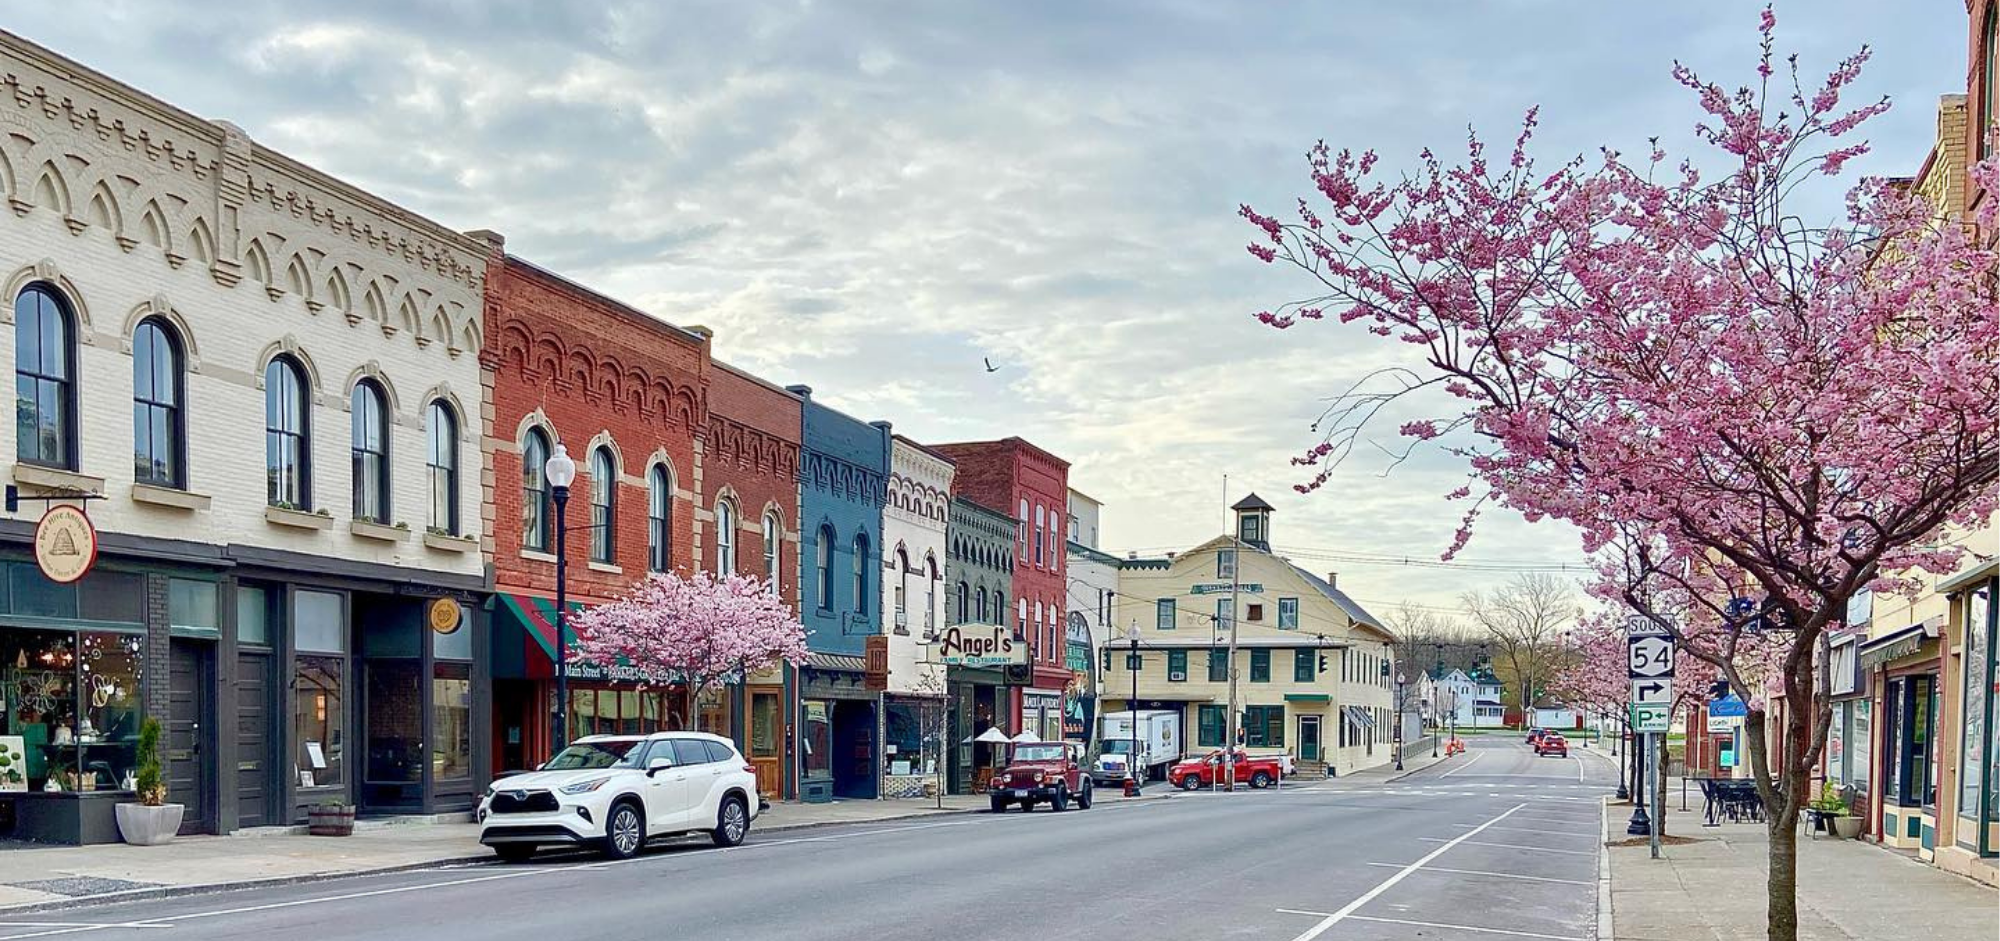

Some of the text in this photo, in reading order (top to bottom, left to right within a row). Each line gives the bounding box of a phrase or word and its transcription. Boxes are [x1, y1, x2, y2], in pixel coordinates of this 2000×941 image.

[939, 626, 1013, 658] Angel's
[939, 656, 1012, 664] FAMILY RESTAURANT
[1633, 646, 1670, 669] 54
[564, 664, 581, 677] Main
[582, 665, 601, 678] Street
